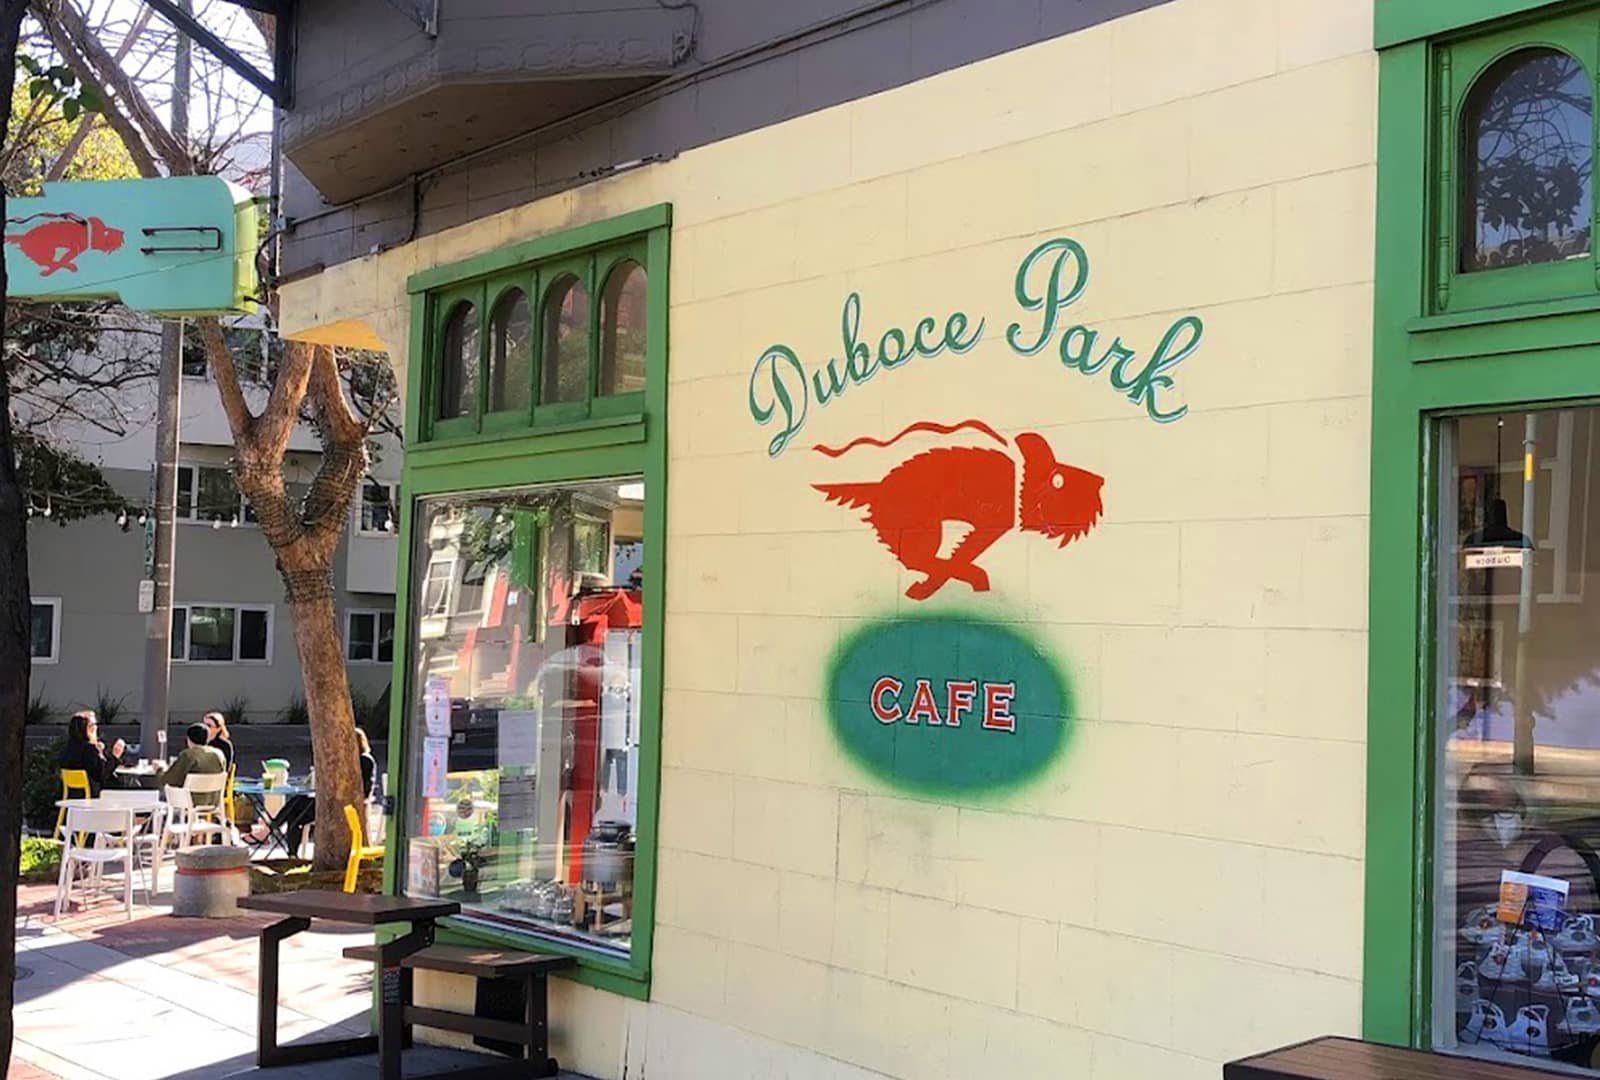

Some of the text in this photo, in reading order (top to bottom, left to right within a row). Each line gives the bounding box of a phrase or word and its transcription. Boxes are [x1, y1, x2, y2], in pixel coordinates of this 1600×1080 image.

[748, 236, 1204, 458] Duboce Park
[869, 675, 1018, 734] CAFE
